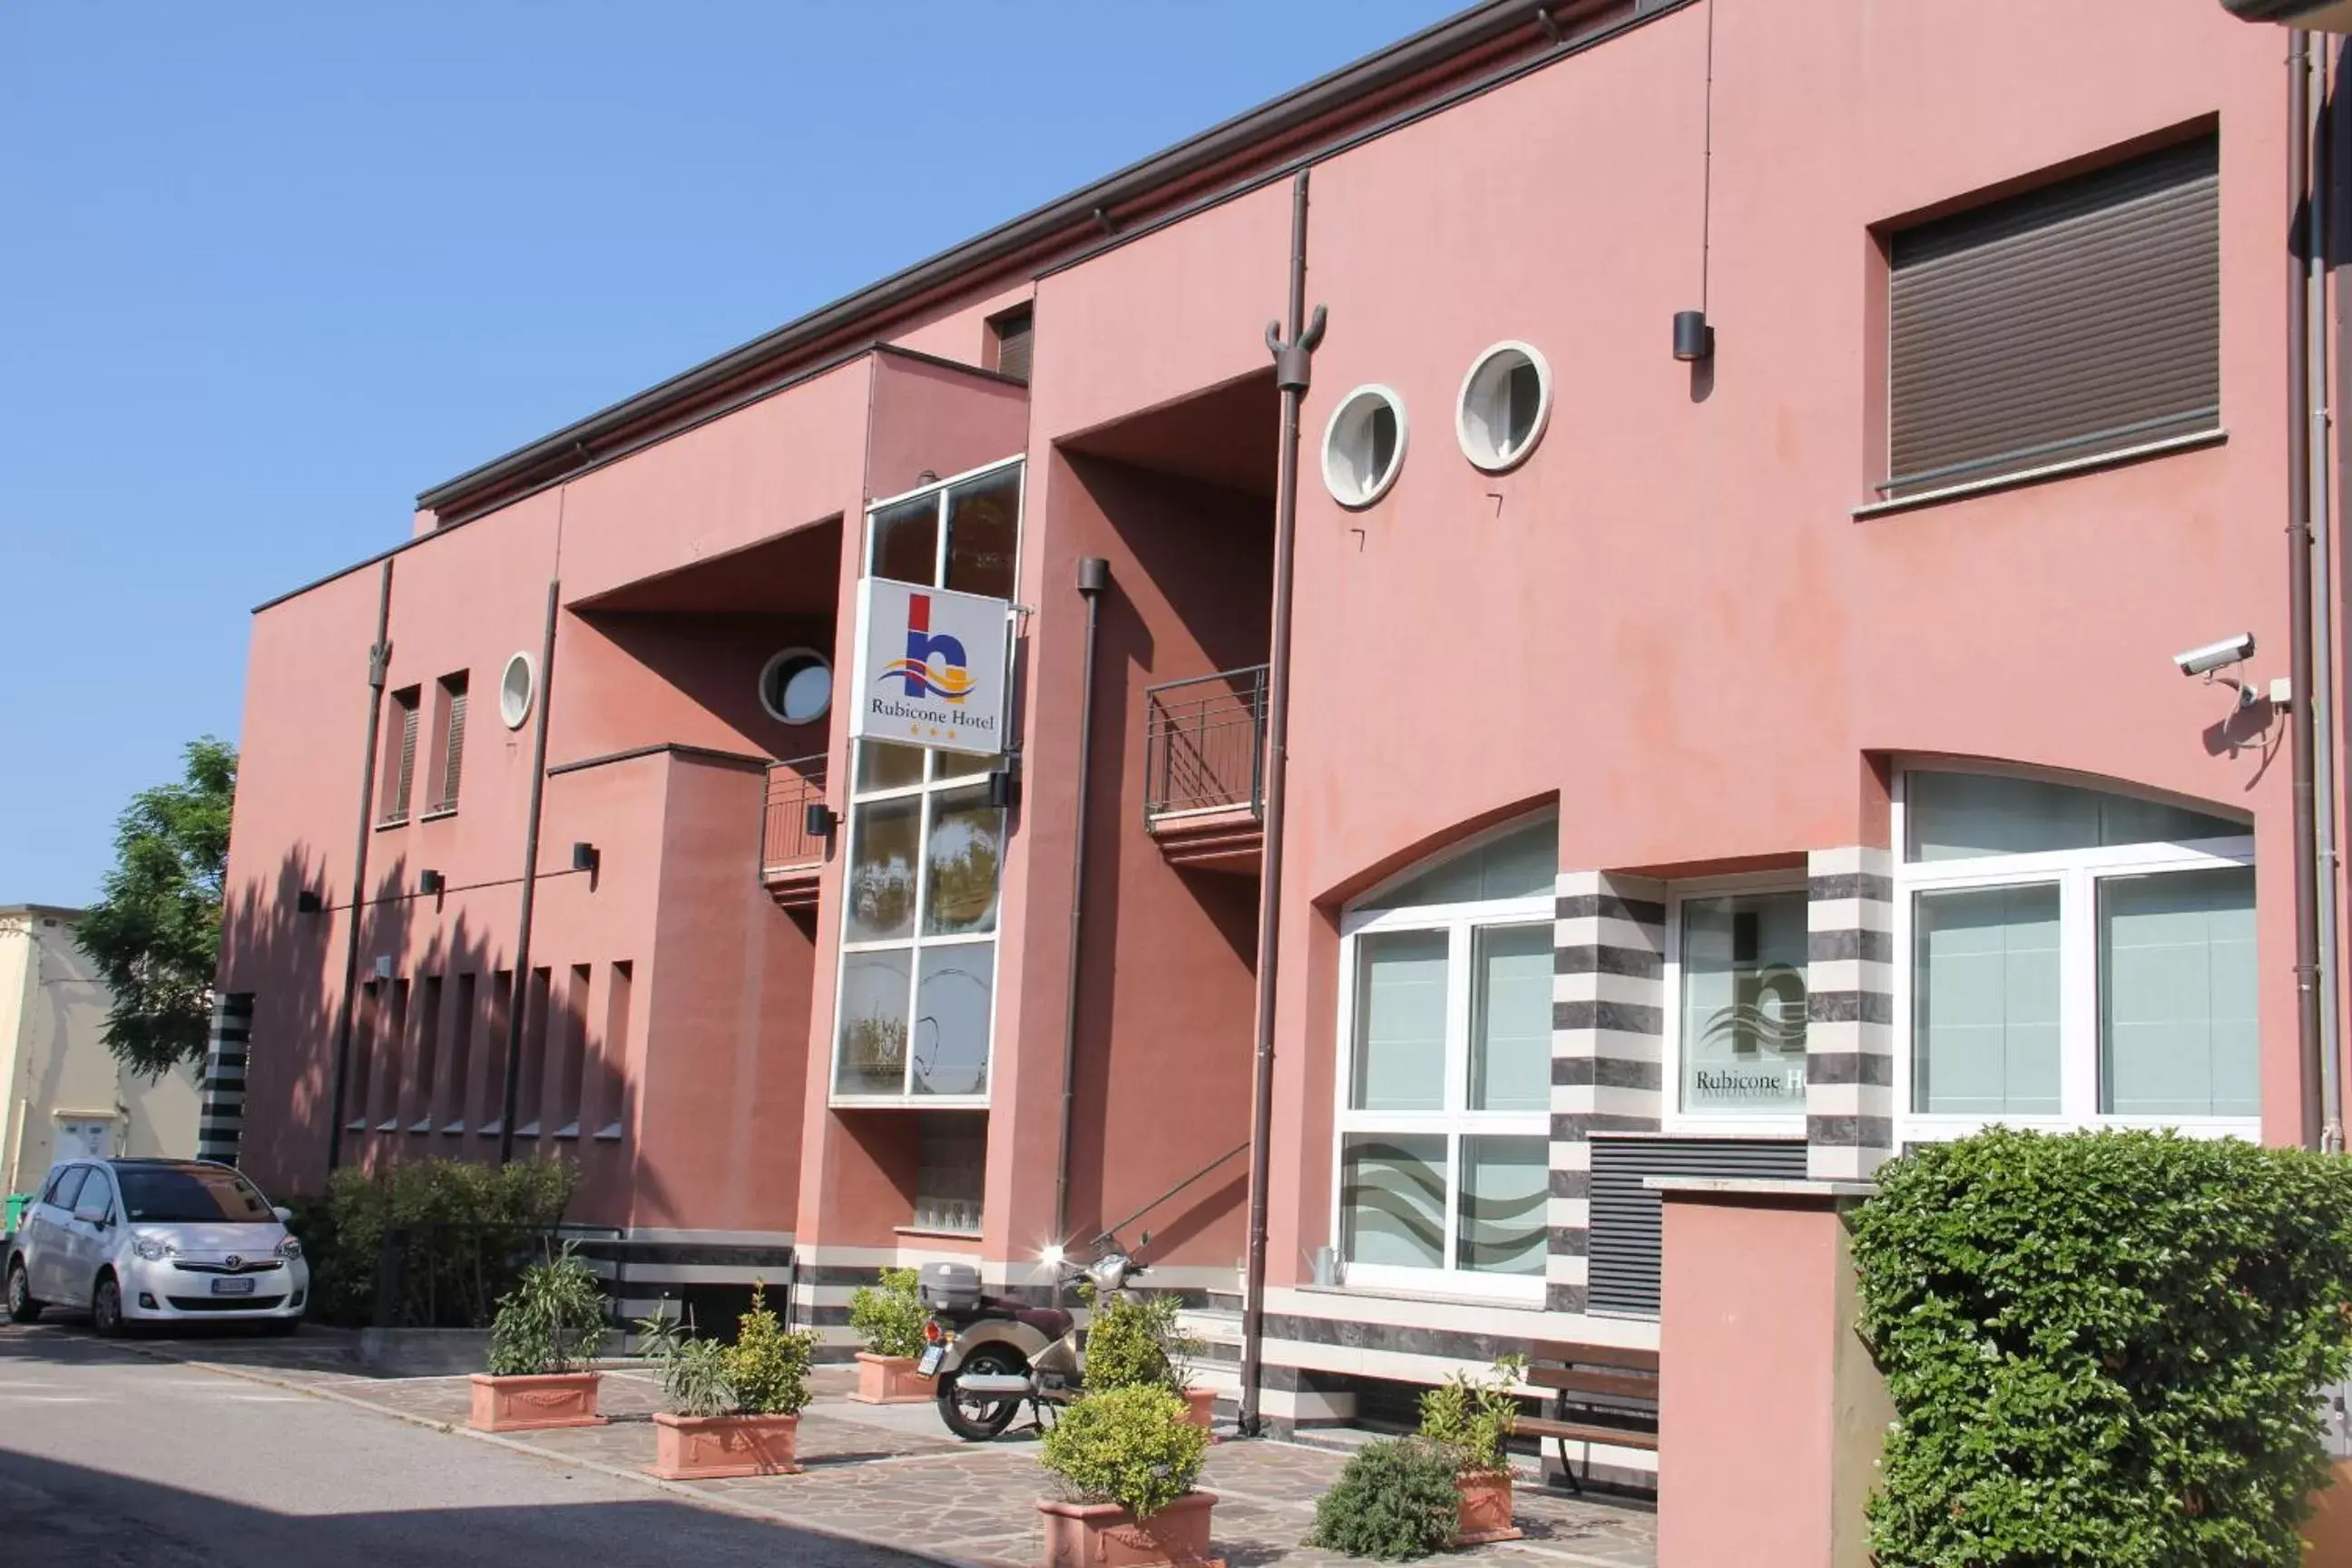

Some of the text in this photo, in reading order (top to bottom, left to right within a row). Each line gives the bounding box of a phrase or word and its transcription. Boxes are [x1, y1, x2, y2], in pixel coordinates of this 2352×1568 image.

[872, 698, 995, 730] Rubicone Hotel
[1696, 1069, 1780, 1089] Rubicone
